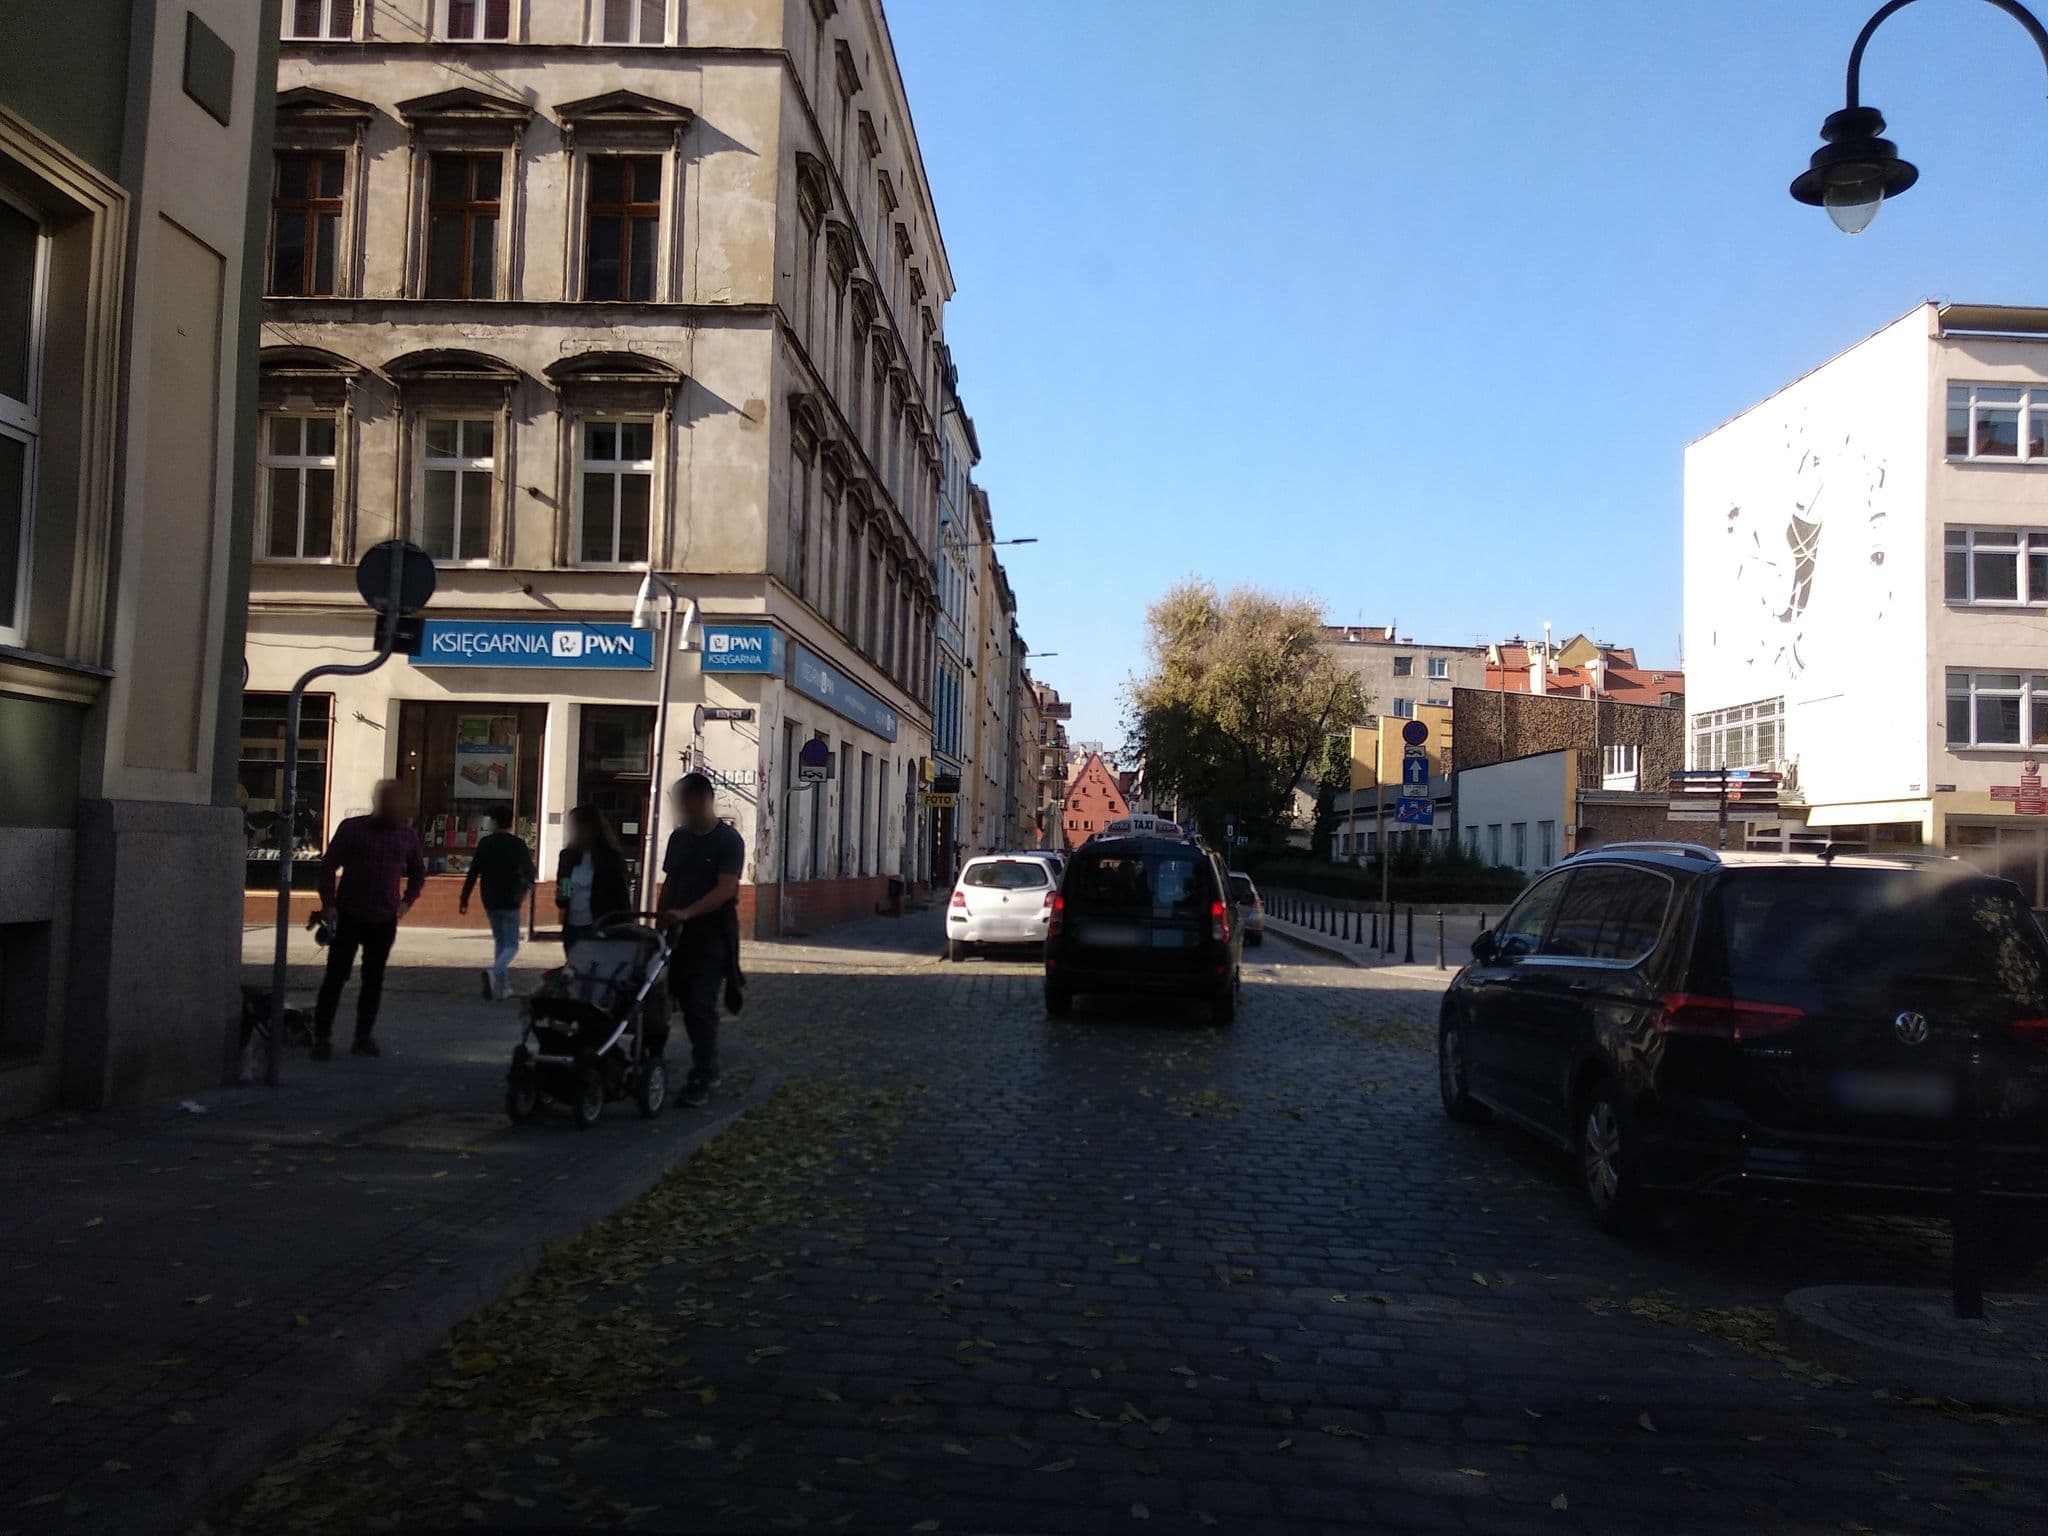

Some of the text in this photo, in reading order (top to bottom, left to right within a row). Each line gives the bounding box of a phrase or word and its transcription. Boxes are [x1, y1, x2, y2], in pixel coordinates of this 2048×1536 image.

[432, 632, 634, 657] KSIĘGARNIA PWN
[730, 637, 761, 651] PWN
[708, 654, 761, 666] KSIĘGARNIA
[925, 795, 951, 804] FOTO
[1133, 819, 1153, 830] TAXI
